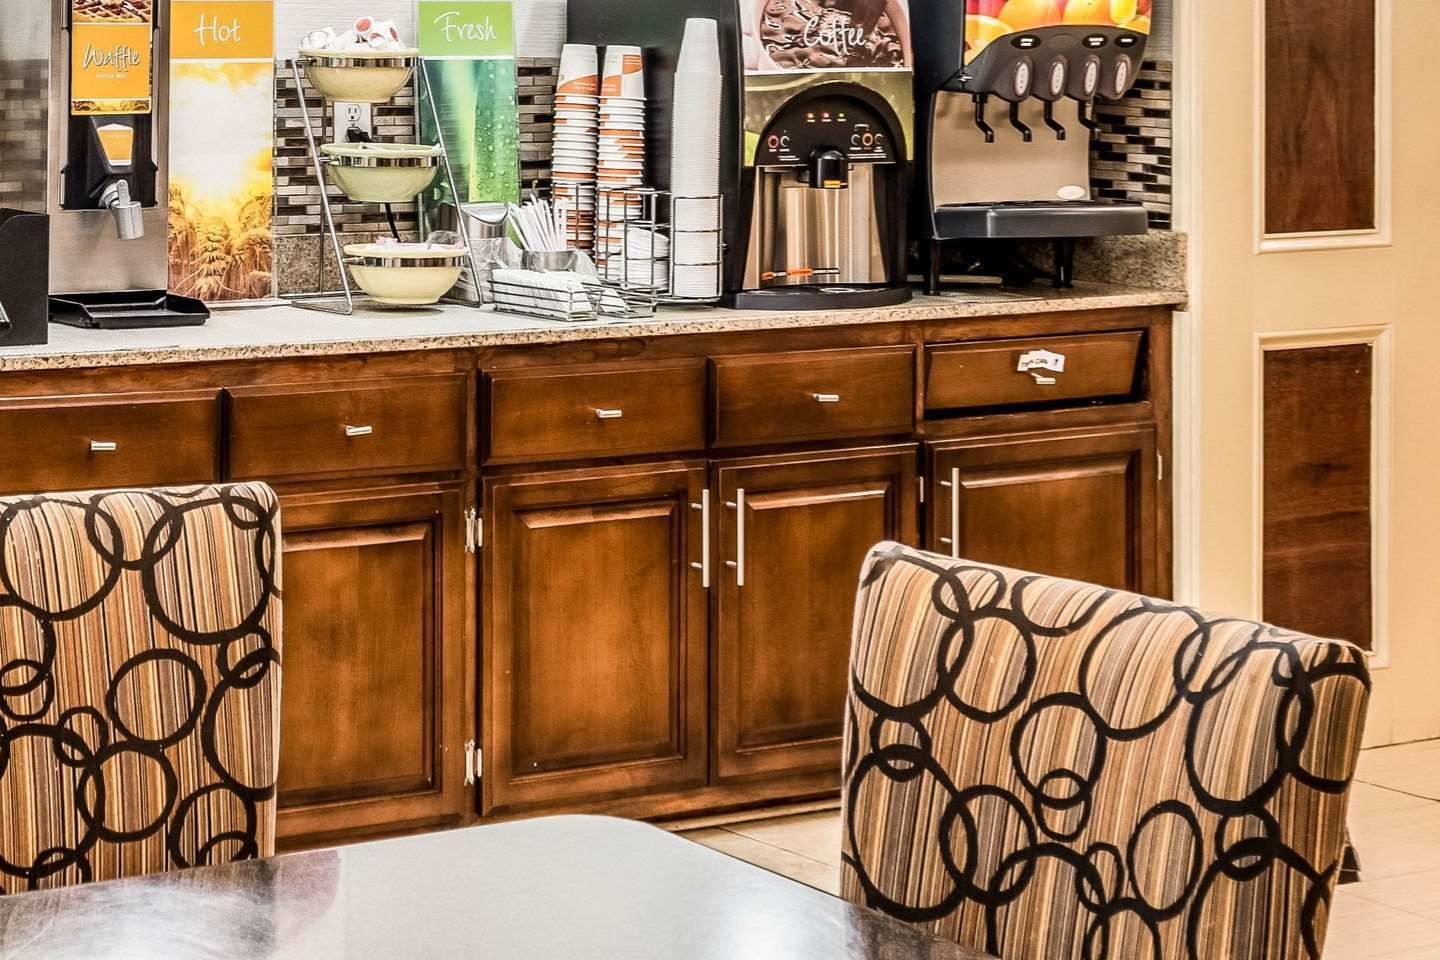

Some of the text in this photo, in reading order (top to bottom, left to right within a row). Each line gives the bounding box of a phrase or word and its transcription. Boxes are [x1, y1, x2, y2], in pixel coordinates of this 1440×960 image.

[193, 13, 241, 46] Hot
[433, 11, 497, 42] Fresh
[803, 14, 866, 56] Coffee
[82, 40, 140, 72] Waffle
